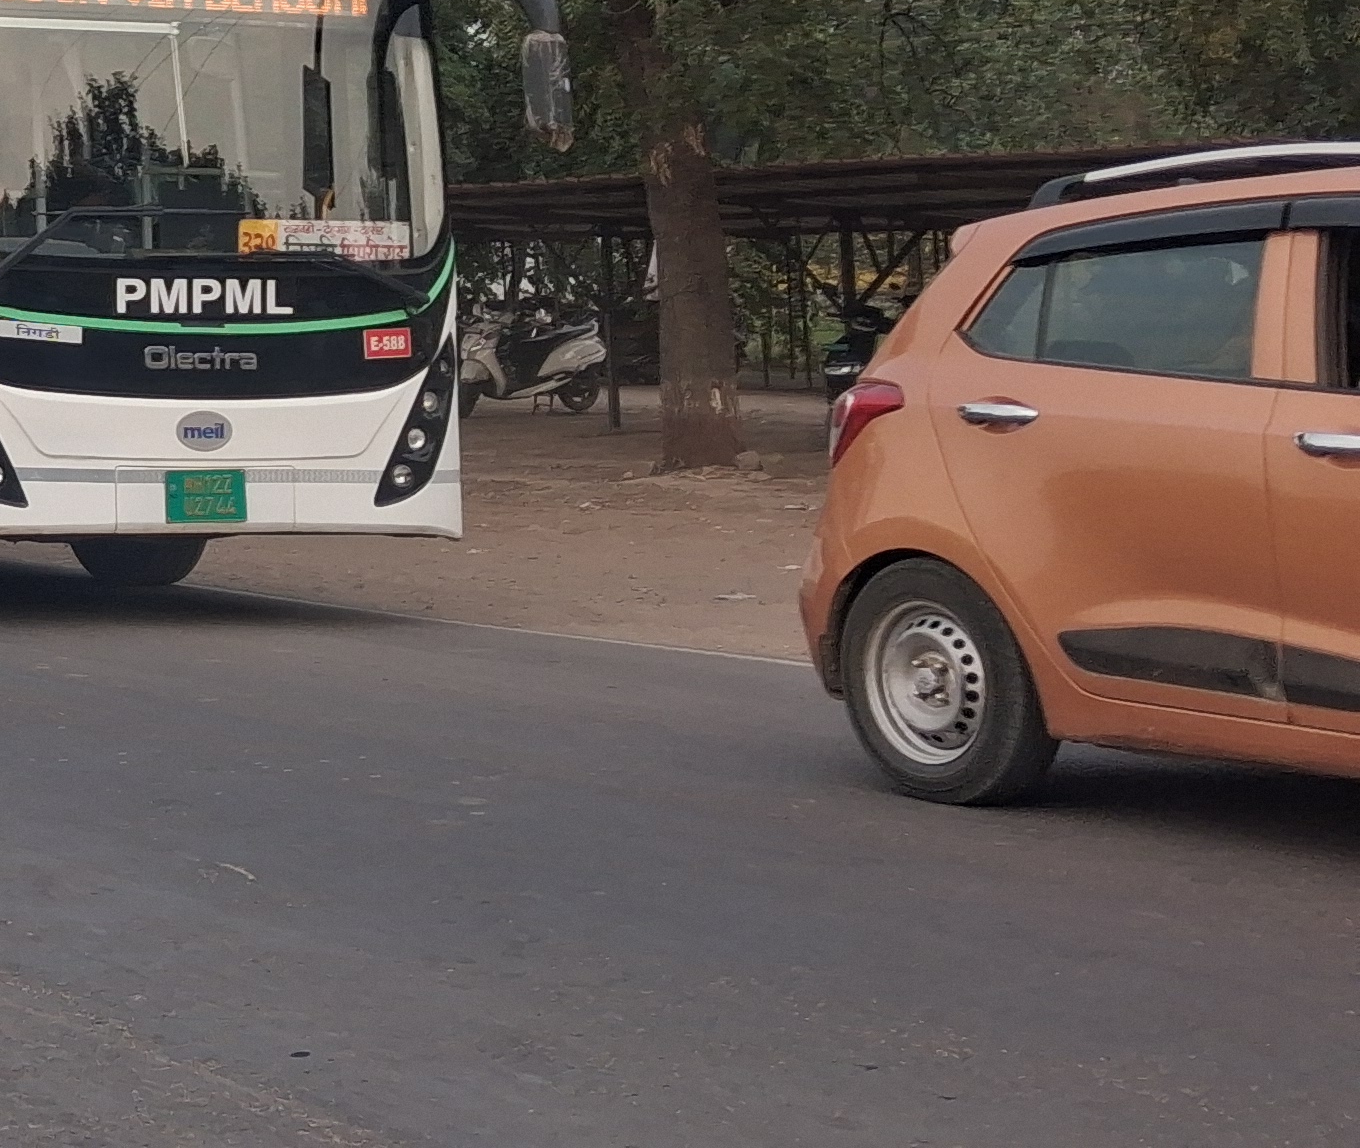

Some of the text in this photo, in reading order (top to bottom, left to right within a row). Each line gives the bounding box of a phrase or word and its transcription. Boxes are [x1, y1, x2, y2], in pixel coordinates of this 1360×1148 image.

[115, 277, 294, 315] PMPML
[143, 345, 258, 371] Olectra
[182, 422, 225, 440] meil
